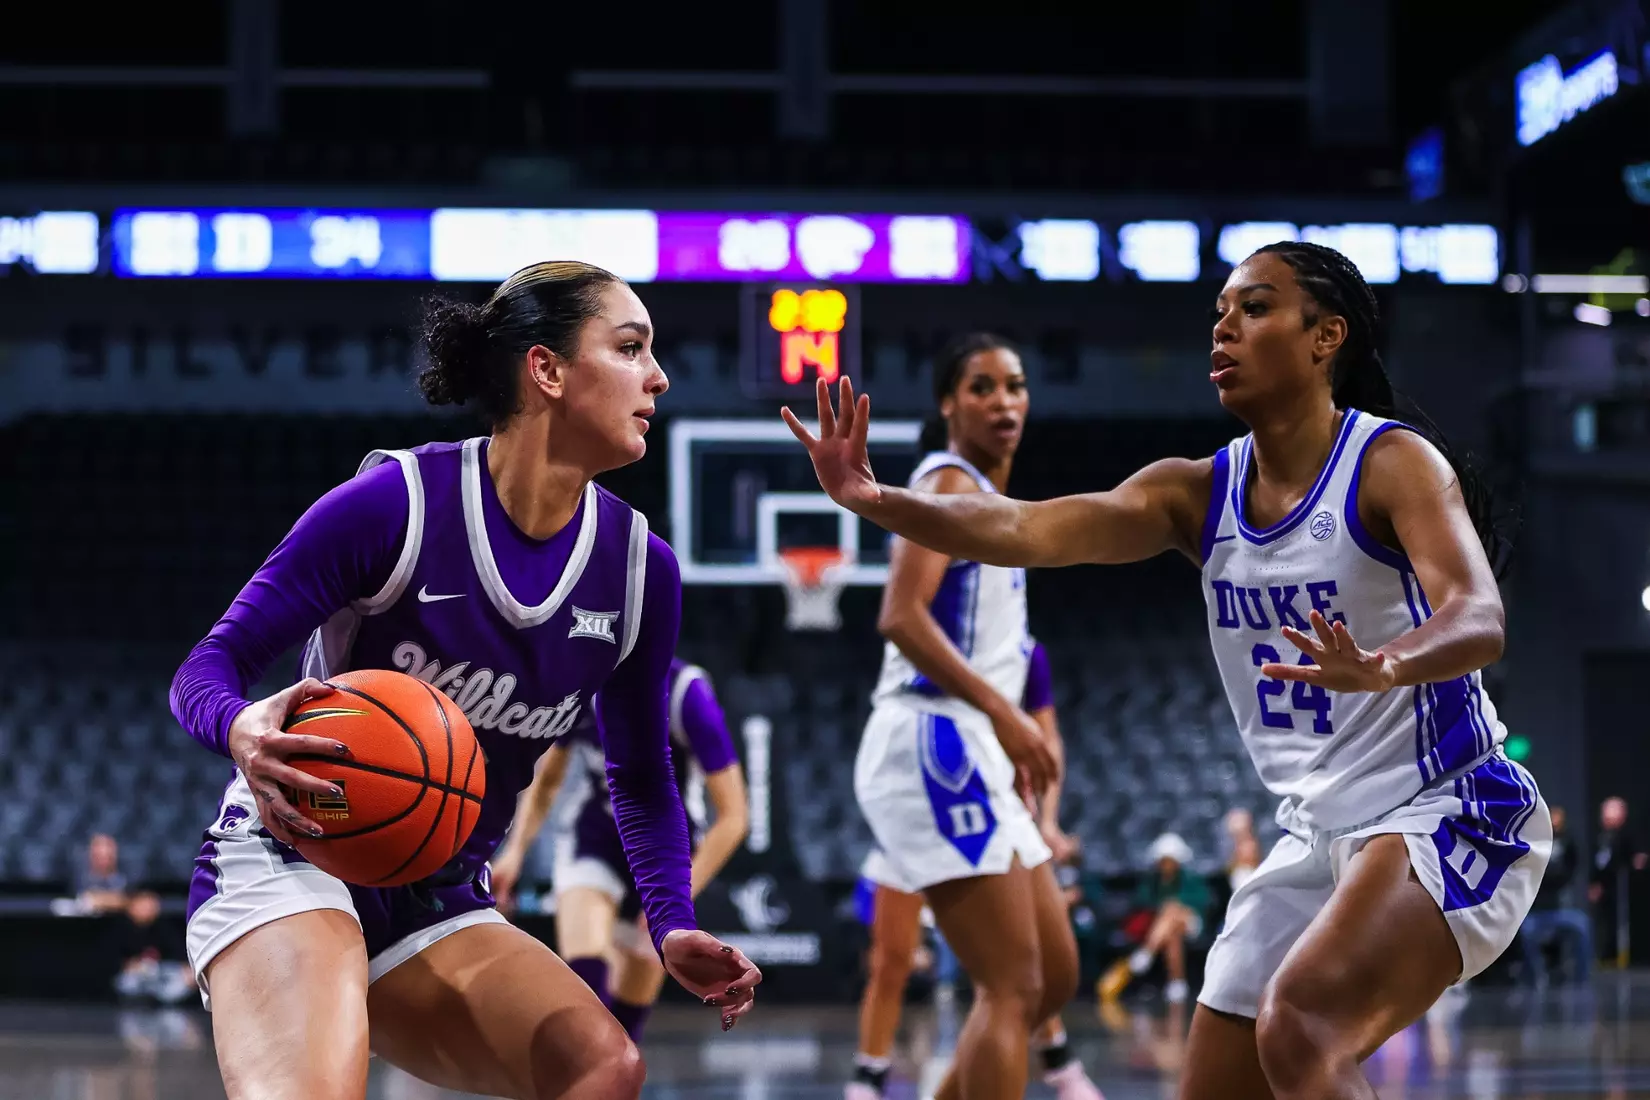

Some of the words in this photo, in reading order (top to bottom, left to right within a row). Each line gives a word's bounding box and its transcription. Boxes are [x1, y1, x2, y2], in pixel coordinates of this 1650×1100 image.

[781, 331, 840, 385] 14
[1211, 580, 1347, 630] DUKE
[1251, 643, 1334, 734] 24
[949, 803, 986, 837] D
[1444, 832, 1489, 890] D
